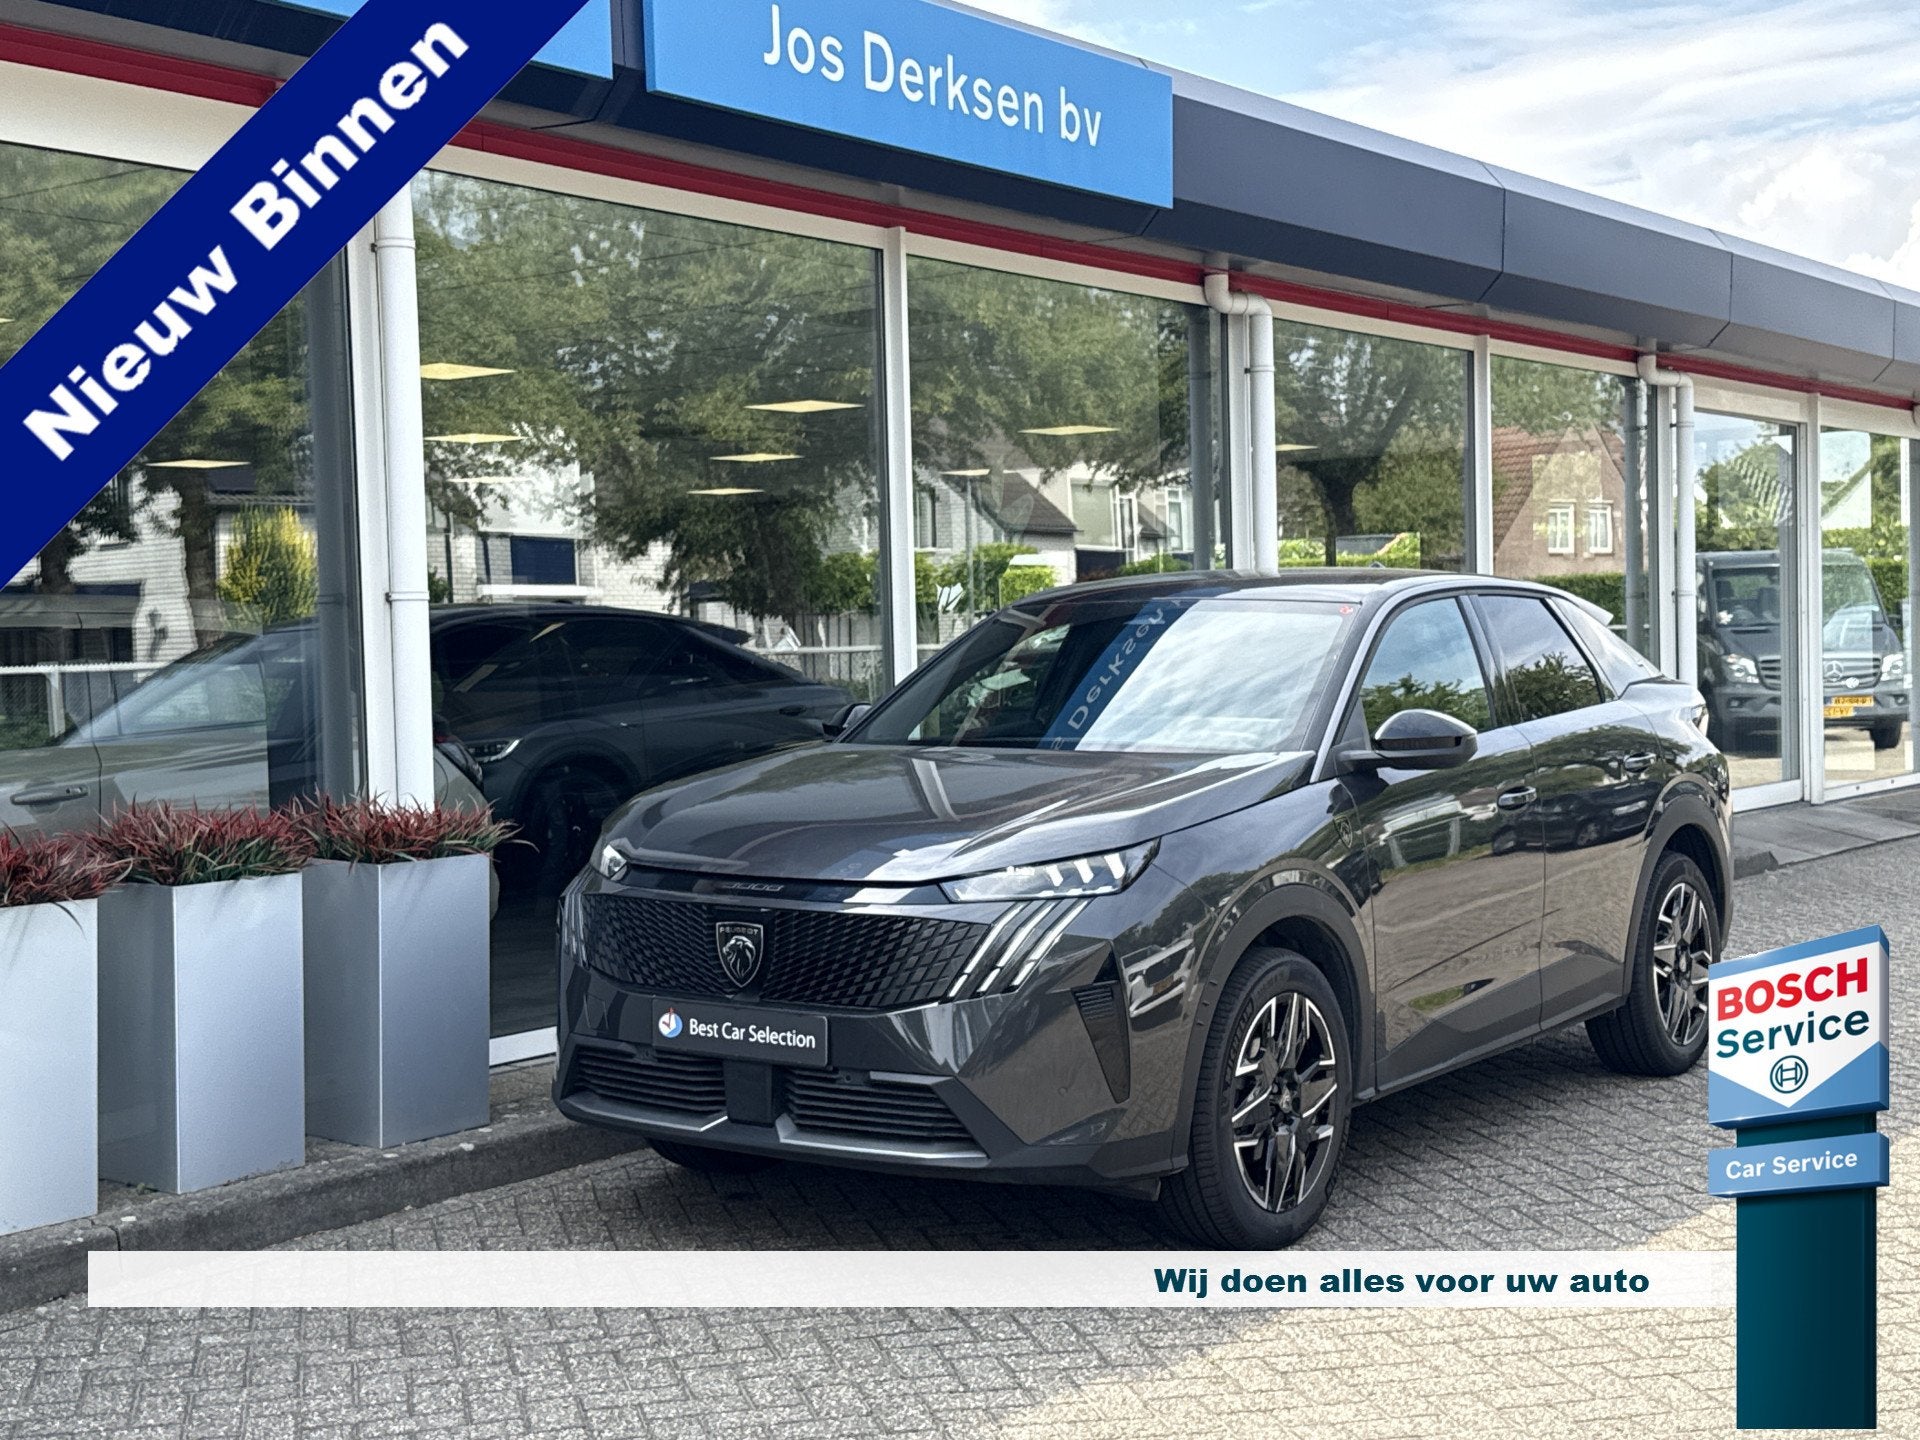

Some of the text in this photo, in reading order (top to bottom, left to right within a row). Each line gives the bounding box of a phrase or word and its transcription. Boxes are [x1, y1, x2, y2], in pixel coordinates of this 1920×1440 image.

[763, 4, 1102, 147] Jos Derksen bv
[719, 926, 759, 936] PEUGEOT
[689, 1018, 816, 1049] Best Car Selection
